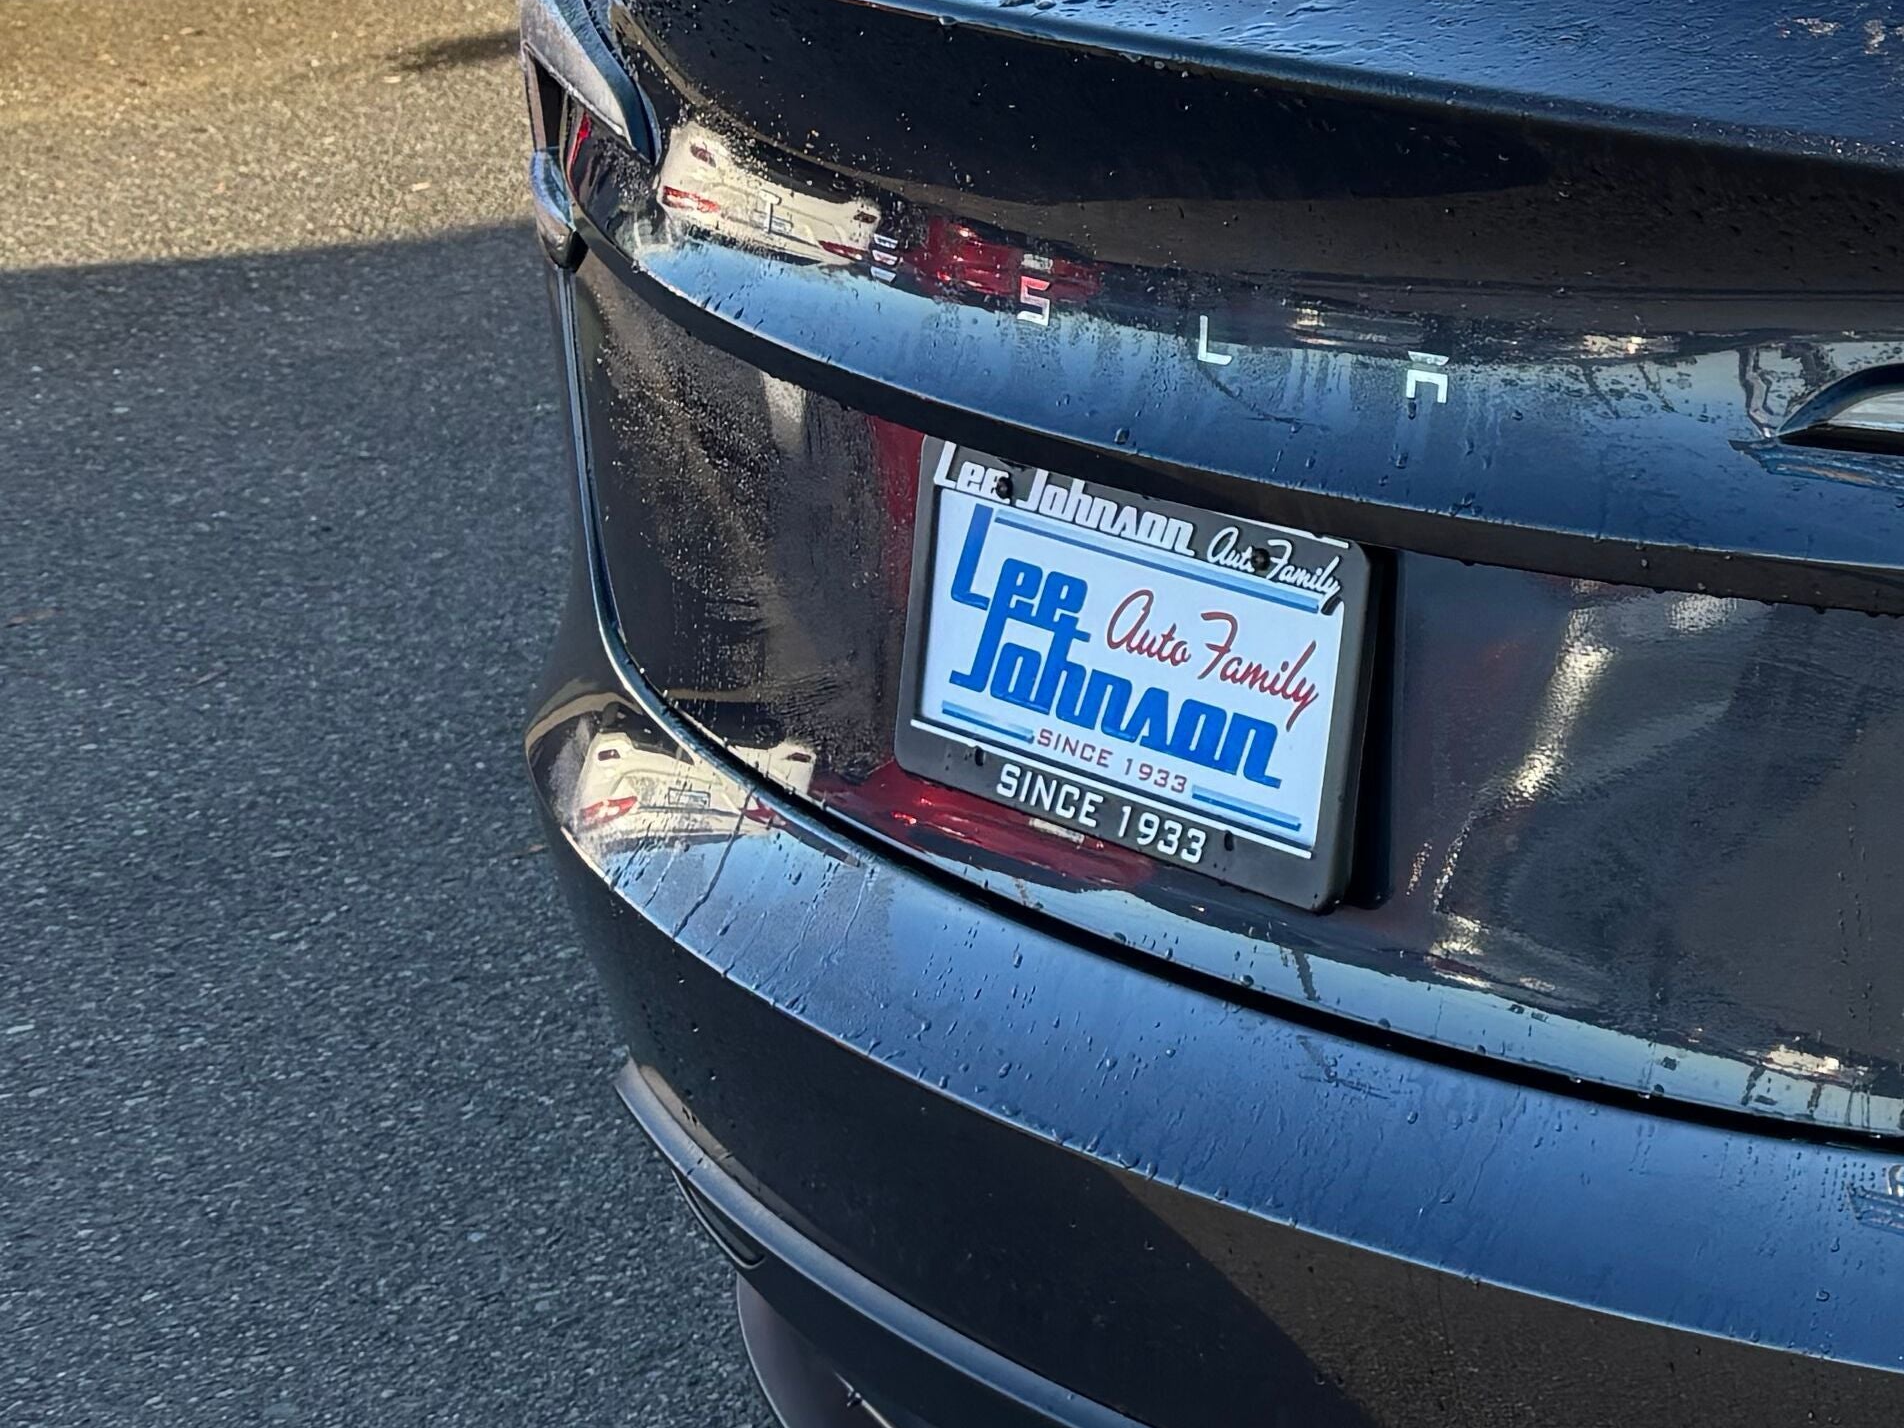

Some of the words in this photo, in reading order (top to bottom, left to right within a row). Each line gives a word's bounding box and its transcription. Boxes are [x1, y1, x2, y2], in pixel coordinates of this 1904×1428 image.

[759, 189, 1449, 403] TESLA
[933, 441, 1011, 505] Lee
[1015, 468, 1195, 557] Johnson
[1206, 527, 1258, 573] Aut
[1266, 539, 1341, 608] Family
[950, 502, 1088, 625] Lee
[949, 609, 1282, 789] Johnson
[1106, 589, 1190, 667] Auto
[1199, 611, 1319, 732] Family
[996, 763, 1104, 829] SINCE
[1117, 804, 1208, 864] 1933
[1034, 728, 1114, 769] SINCE
[1126, 755, 1188, 794] 1933
